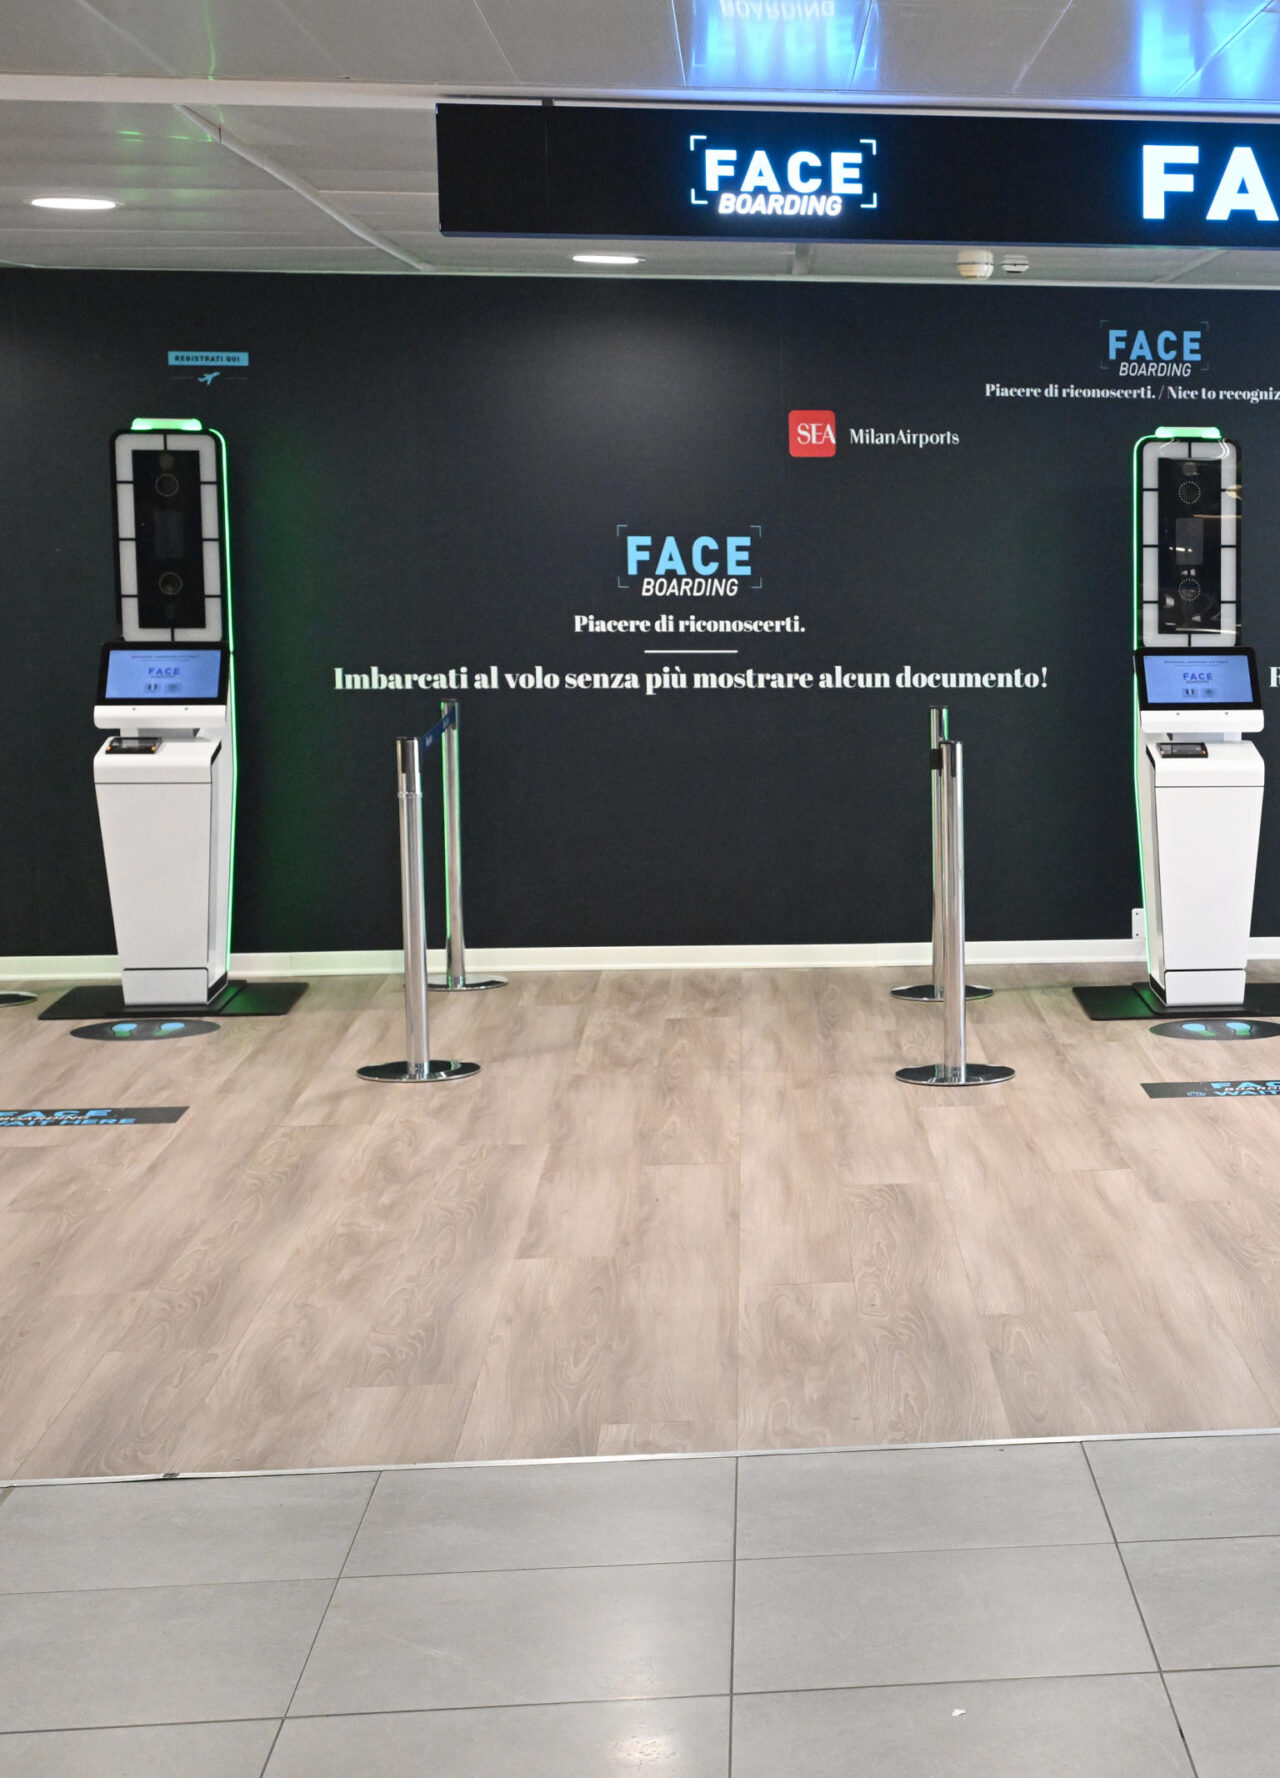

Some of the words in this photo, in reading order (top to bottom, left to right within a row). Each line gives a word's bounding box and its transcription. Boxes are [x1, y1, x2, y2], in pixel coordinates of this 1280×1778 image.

[705, 149, 863, 194] FACE
[718, 193, 843, 216] BOARDING
[1108, 329, 1202, 362] FACE
[1118, 362, 1192, 377] BOARDING
[985, 383, 1042, 398] Piacere
[1045, 384, 1059, 398] di
[1062, 385, 1156, 399] riconoscerti.
[1167, 386, 1199, 400] Nice
[1201, 387, 1215, 400] to
[797, 423, 836, 444] SEA
[849, 428, 960, 448] MilanAirports
[626, 535, 753, 577] FACE
[641, 577, 740, 598] BOARDING
[574, 614, 650, 633] Piacere
[654, 614, 675, 632] di
[678, 614, 806, 633] riconoscerti.
[148, 667, 180, 675] FACE
[334, 666, 469, 690] Imbarcati
[473, 666, 499, 689] al
[504, 666, 560, 689] volo
[564, 672, 640, 689] senza
[645, 666, 688, 695] più
[693, 668, 814, 689] mostrare
[818, 666, 891, 689] alcun
[895, 665, 1048, 689] documento!
[1182, 672, 1213, 681] FACE
